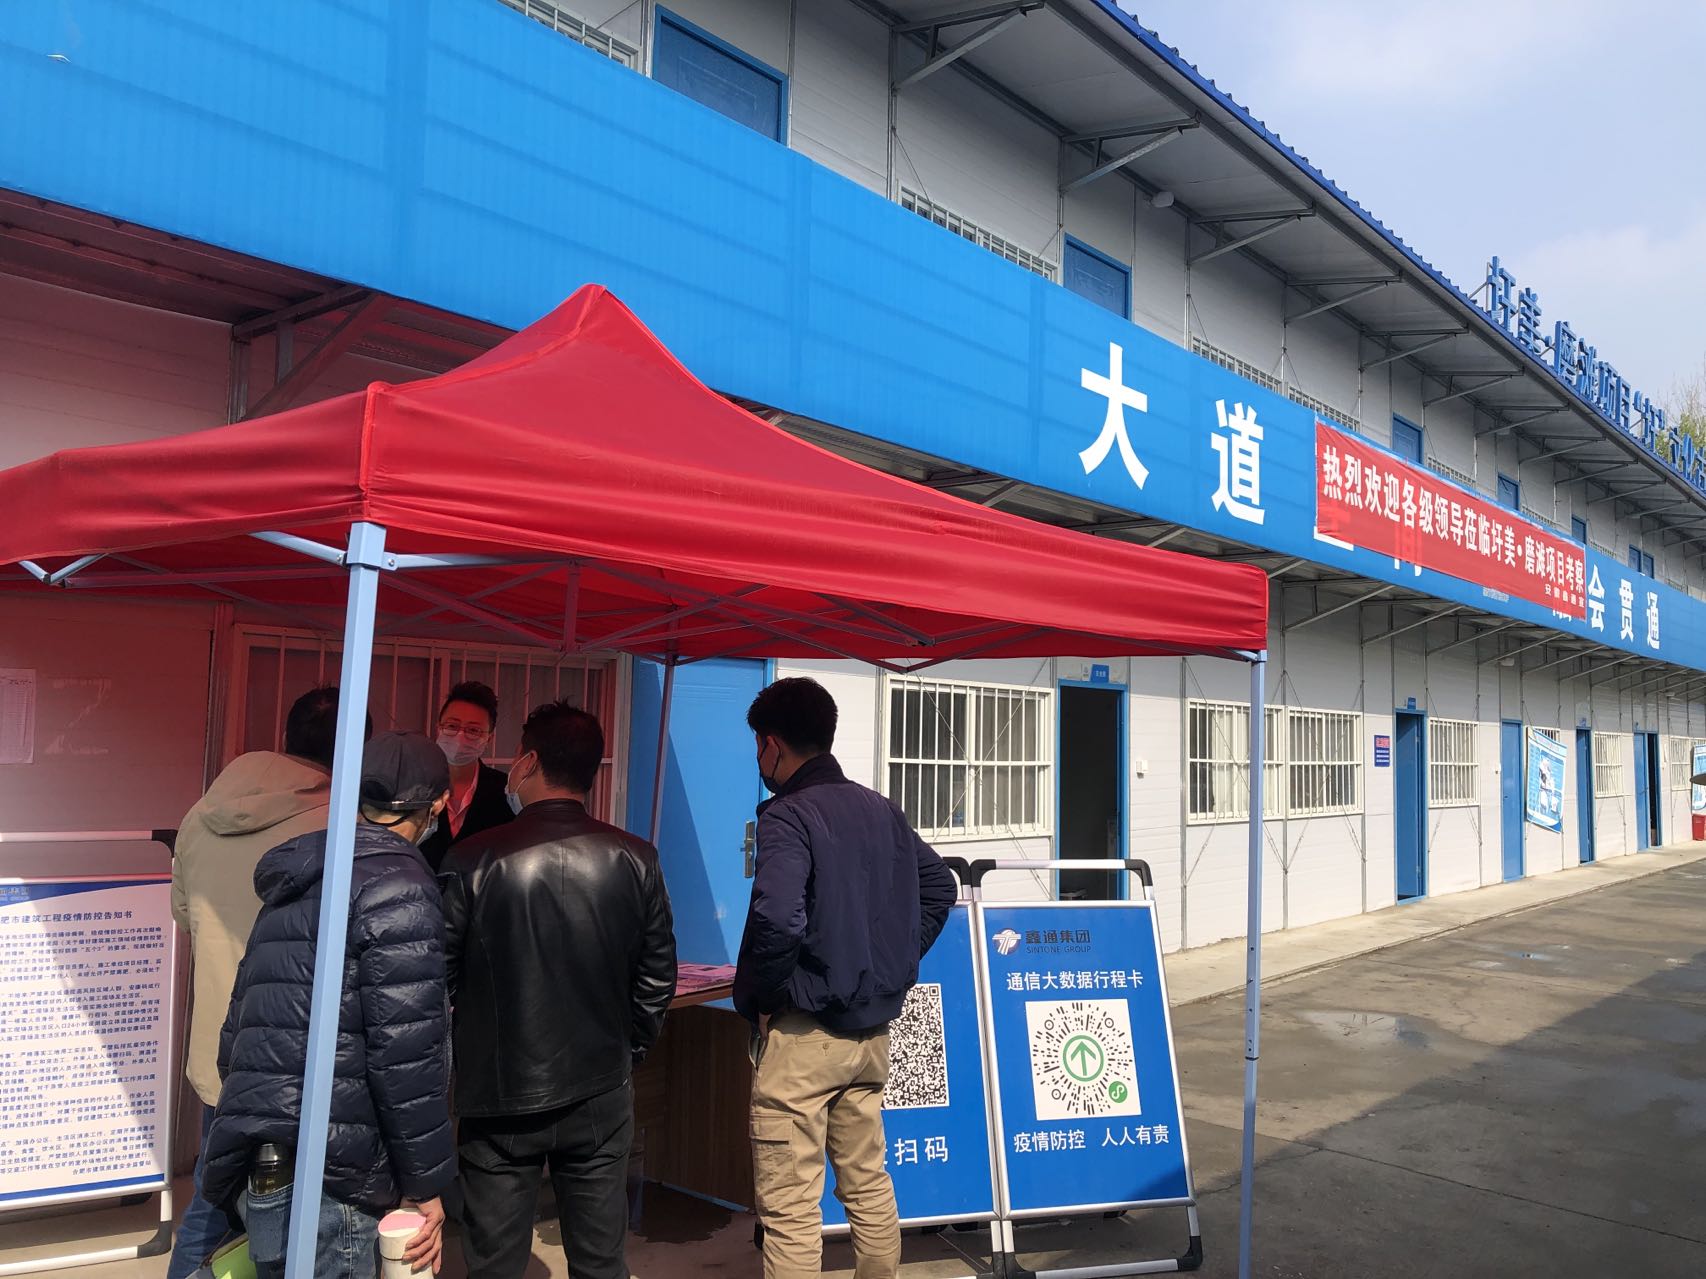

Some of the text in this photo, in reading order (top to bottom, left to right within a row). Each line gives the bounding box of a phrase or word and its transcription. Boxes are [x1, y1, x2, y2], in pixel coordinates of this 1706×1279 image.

[1078, 341, 1265, 525] 大道
[1025, 929, 1091, 945] 鑫通集团
[1026, 945, 1092, 954] SINTONE GROUP
[1006, 970, 1144, 992] 通信大数据行程卡
[884, 1135, 949, 1167] 扫码
[1013, 1124, 1170, 1153] 疫情防控 人人有责
